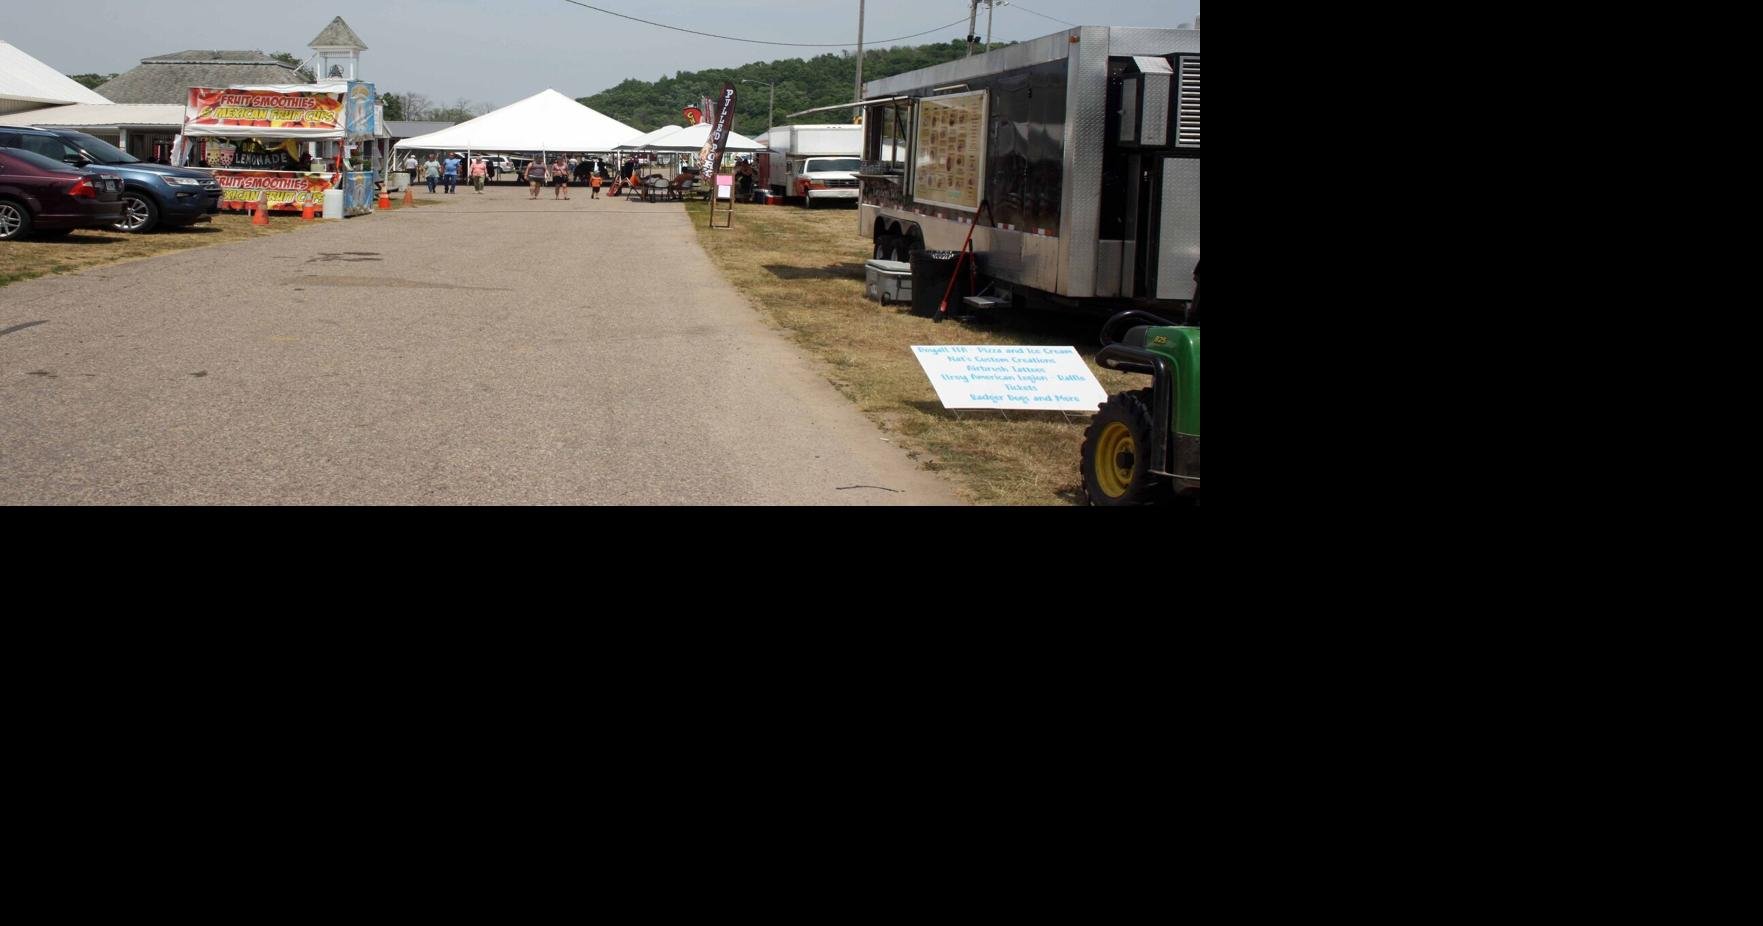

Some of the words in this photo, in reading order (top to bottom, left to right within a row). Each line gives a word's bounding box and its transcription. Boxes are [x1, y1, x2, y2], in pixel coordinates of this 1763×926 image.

[220, 94, 251, 107] FRUIT
[252, 95, 316, 109] SMOOTHIES
[215, 107, 268, 120] MEXICAN
[269, 108, 303, 121] FRUIT
[304, 110, 336, 123] CUPS
[714, 88, 734, 141] PULLED
[235, 153, 289, 165] LEMONADE
[242, 177, 309, 189] SMOOTHIES
[223, 190, 260, 202] XICAN
[296, 191, 324, 204] CPS
[1042, 347, 1073, 355] Cream
[966, 365, 1009, 373] Airbrush
[970, 373, 1015, 381] American
[1056, 374, 1086, 382] Raffle
[1004, 383, 1038, 392] Tickets
[969, 393, 1004, 404] Badger
[1033, 394, 1053, 402] and
[1054, 394, 1080, 402] More
